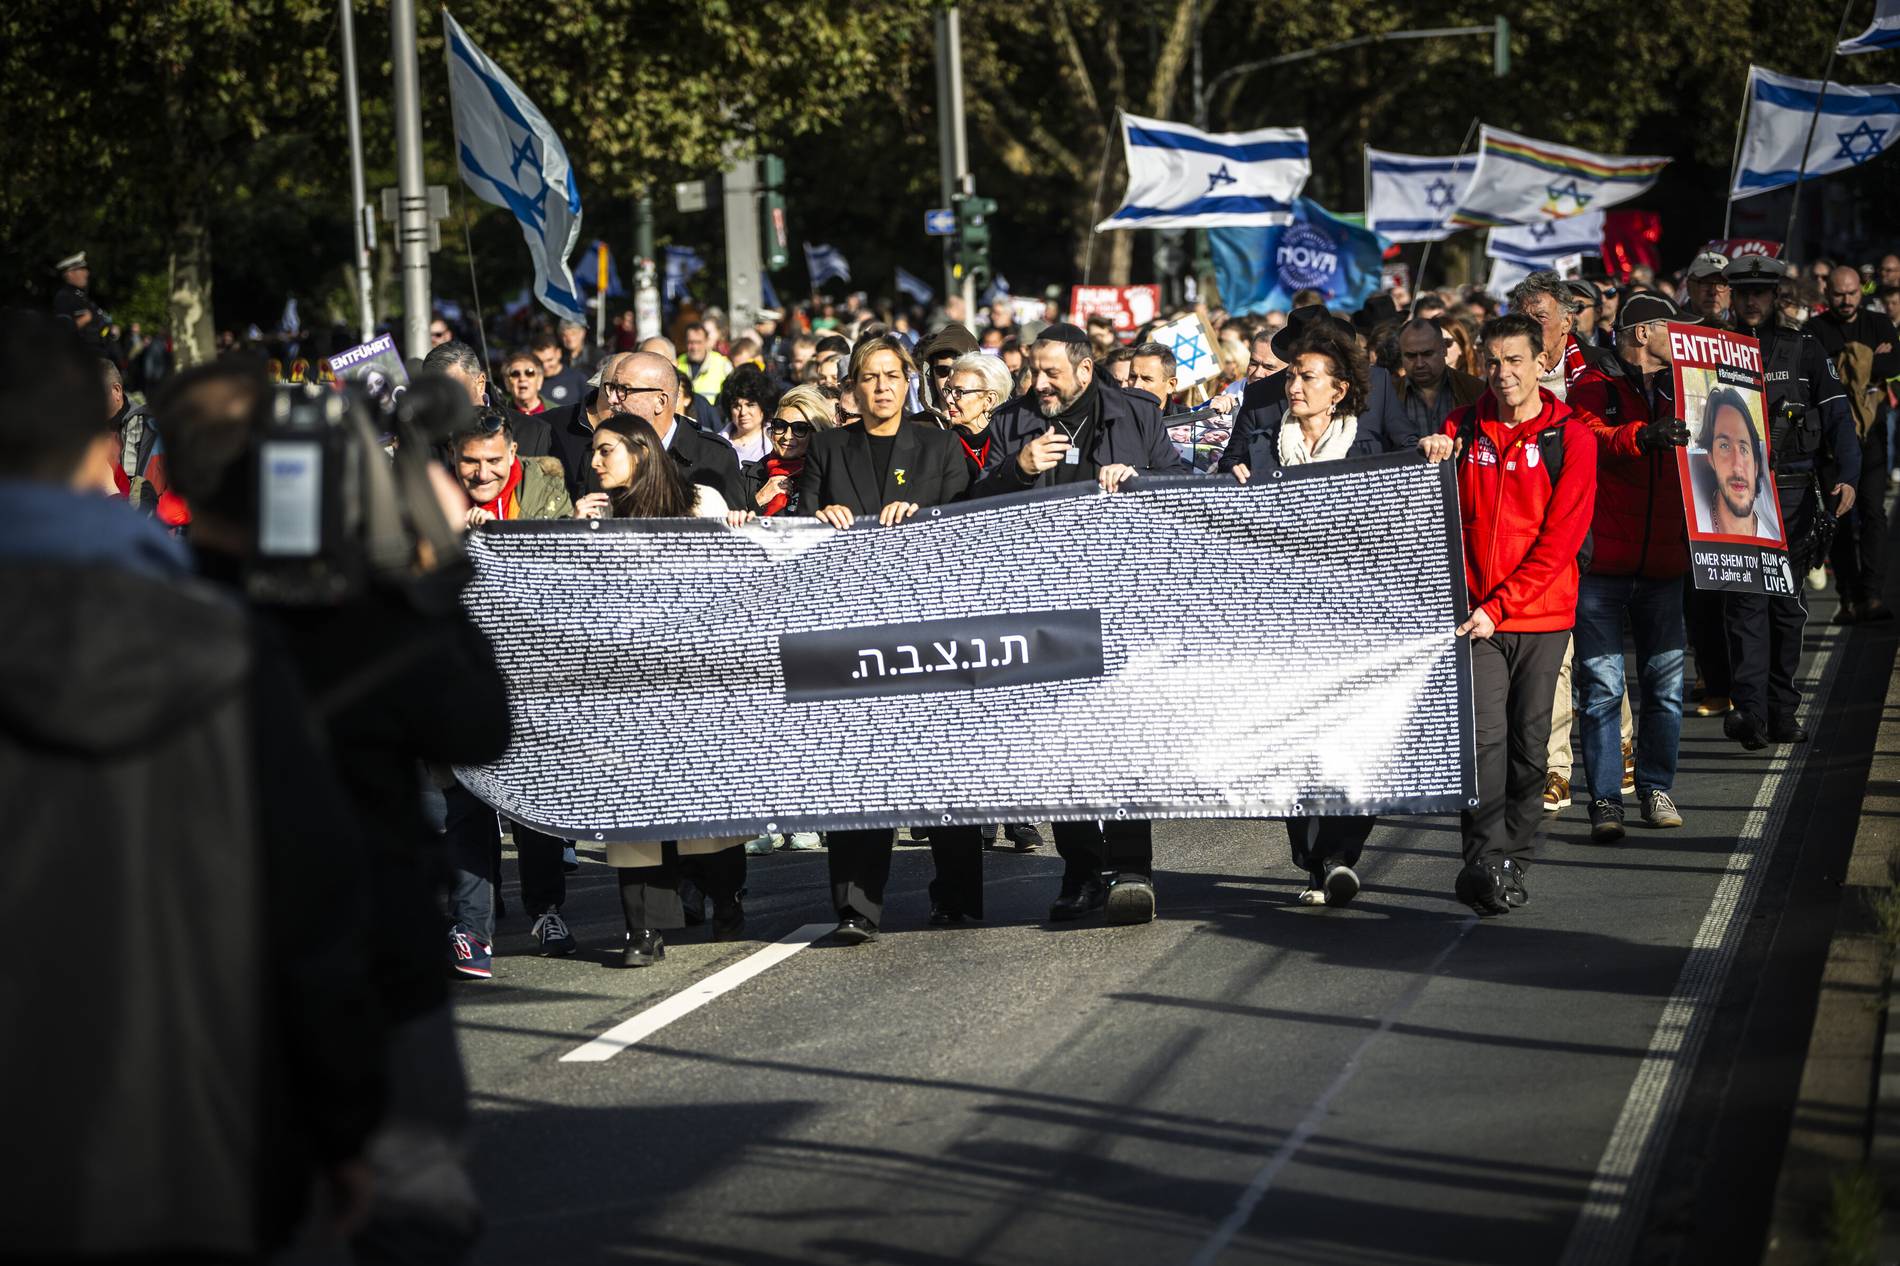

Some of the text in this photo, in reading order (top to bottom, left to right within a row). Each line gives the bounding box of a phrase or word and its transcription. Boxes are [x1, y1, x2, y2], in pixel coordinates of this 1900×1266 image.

[1670, 332, 1760, 372] ENTFÜHRT
[1694, 552, 1758, 568] OMER SHEM TOV
[1761, 552, 1778, 567] RUN
[1708, 568, 1752, 582] 21 Jahre alt
[1764, 575, 1786, 592] LIVE
[852, 634, 1029, 679] ת.נ.צ.ב.ה.
